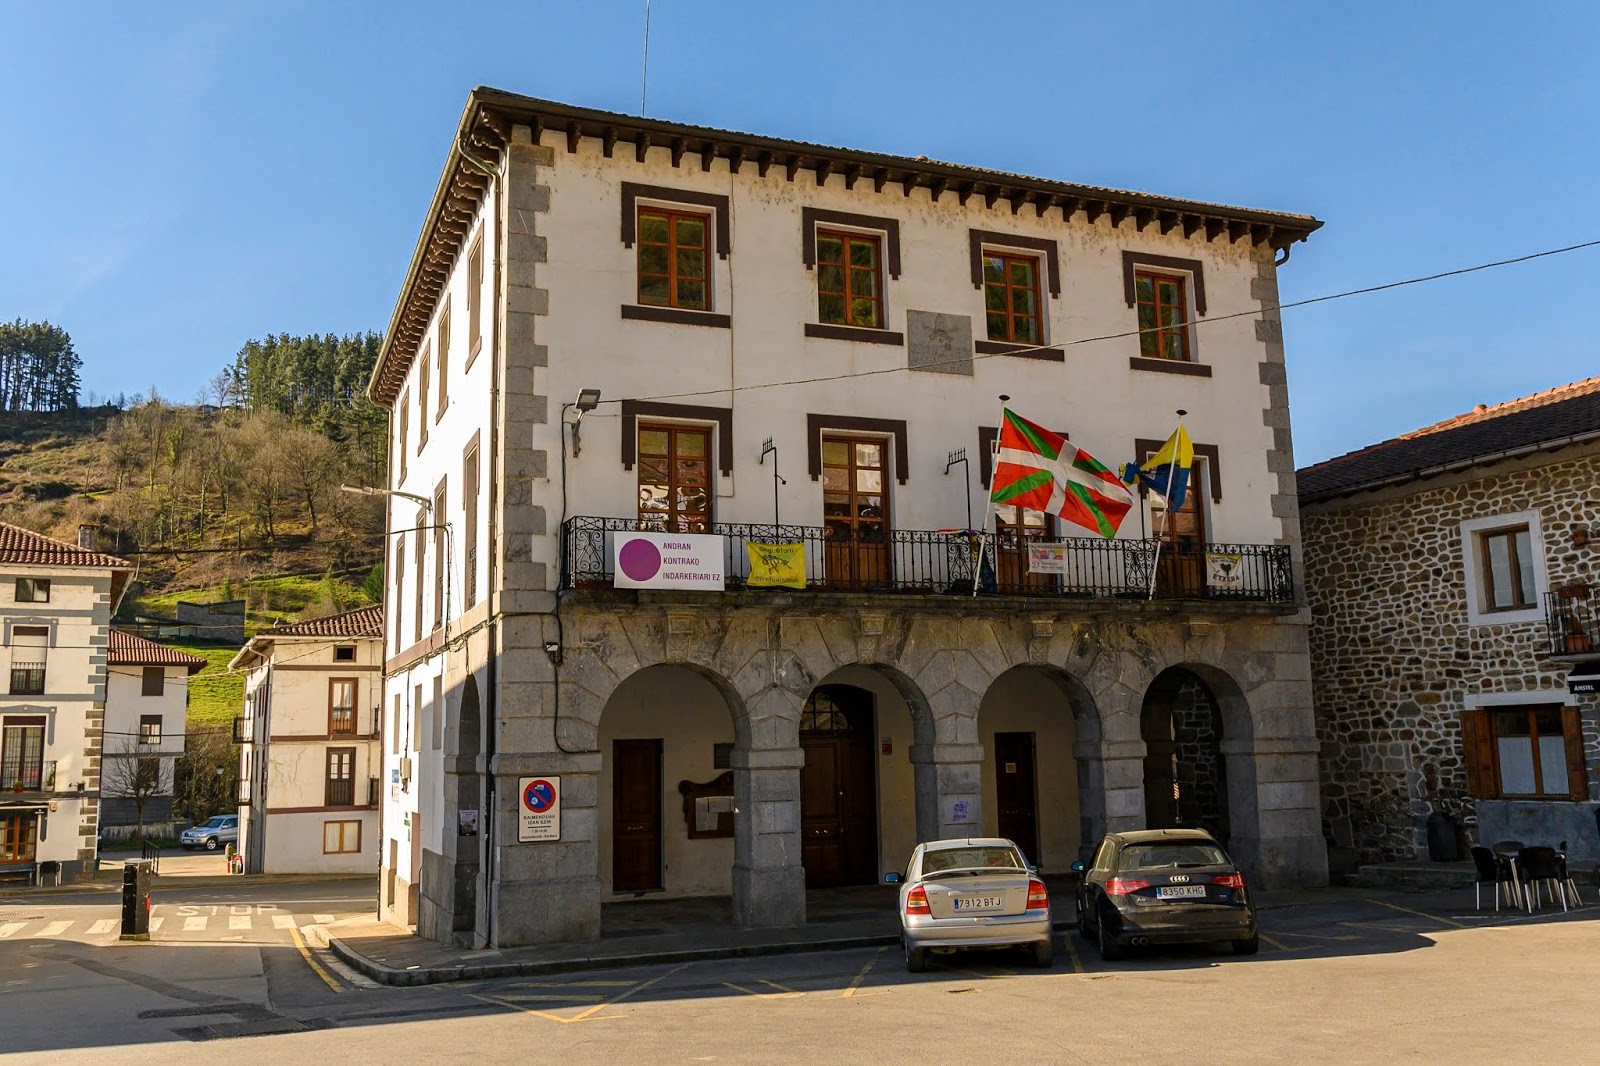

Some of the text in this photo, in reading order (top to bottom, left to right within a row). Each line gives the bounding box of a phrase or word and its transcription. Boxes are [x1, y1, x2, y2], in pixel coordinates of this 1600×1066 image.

[662, 542, 692, 551] ANDRAN
[663, 557, 700, 566] KONTRAKO
[662, 572, 721, 581] INDARKERIARI EZ
[1212, 573, 1240, 582] ETXERA
[1162, 886, 1204, 897] 8350 KHG
[959, 897, 1001, 908] 7312 BTJ
[177, 904, 278, 916] STOP
